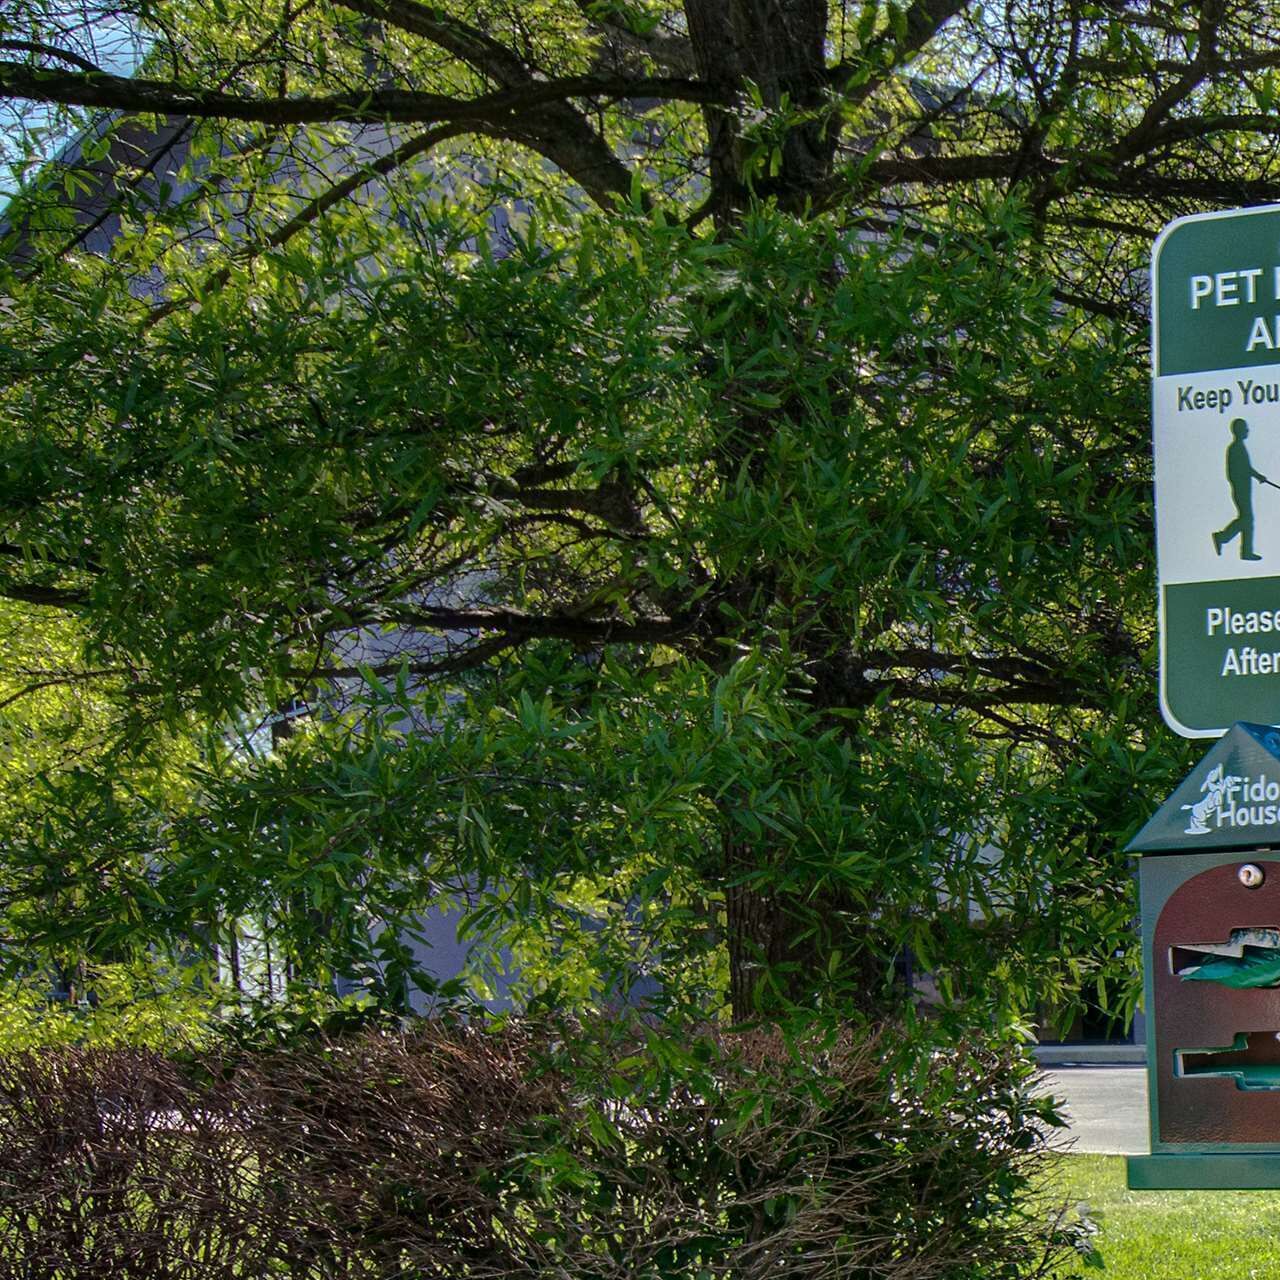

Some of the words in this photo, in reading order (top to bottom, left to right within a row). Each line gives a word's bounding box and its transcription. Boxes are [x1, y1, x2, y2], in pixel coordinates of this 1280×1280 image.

[1190, 268, 1264, 310] PET
[1177, 385, 1232, 414] Keep
[1226, 774, 1280, 803] Fido
